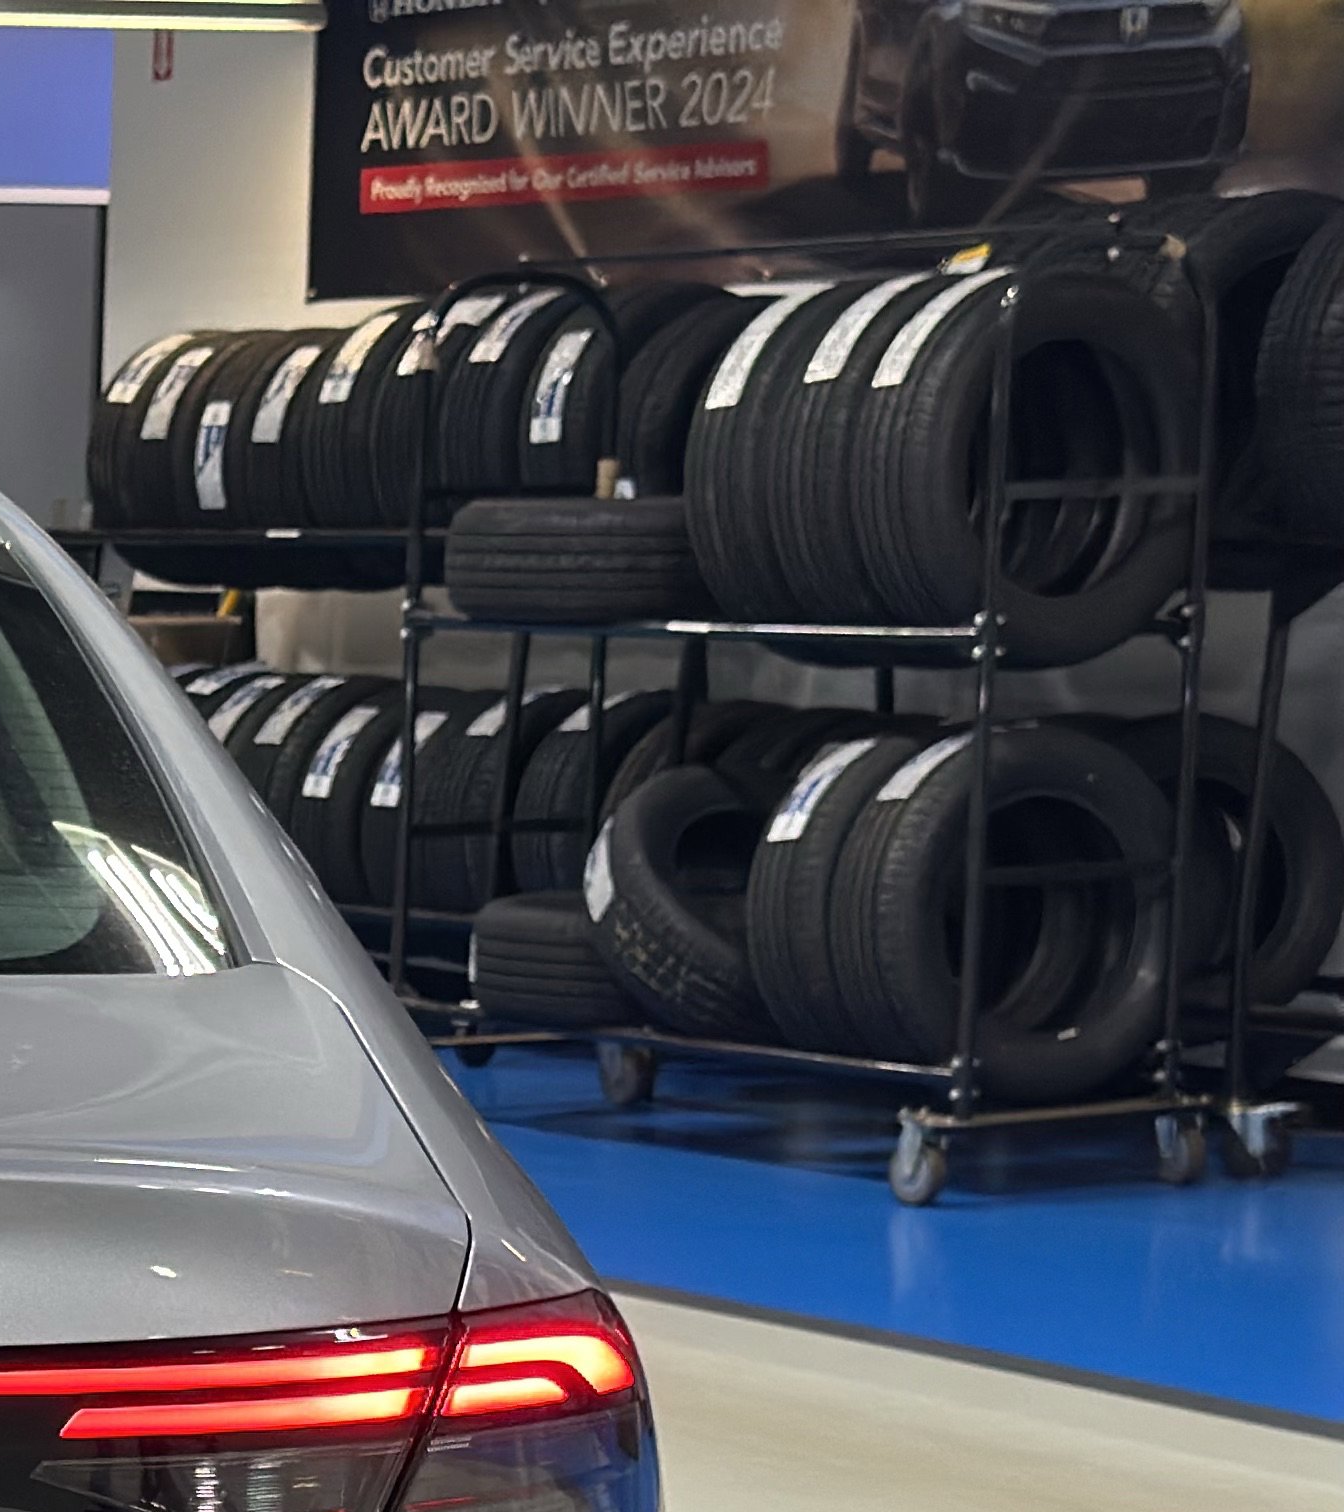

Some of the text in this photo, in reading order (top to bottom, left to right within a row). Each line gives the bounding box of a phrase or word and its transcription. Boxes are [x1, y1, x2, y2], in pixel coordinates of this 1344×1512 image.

[363, 14, 783, 88] Customer Service Experience
[360, 66, 776, 153] AWARD WINNER 2024
